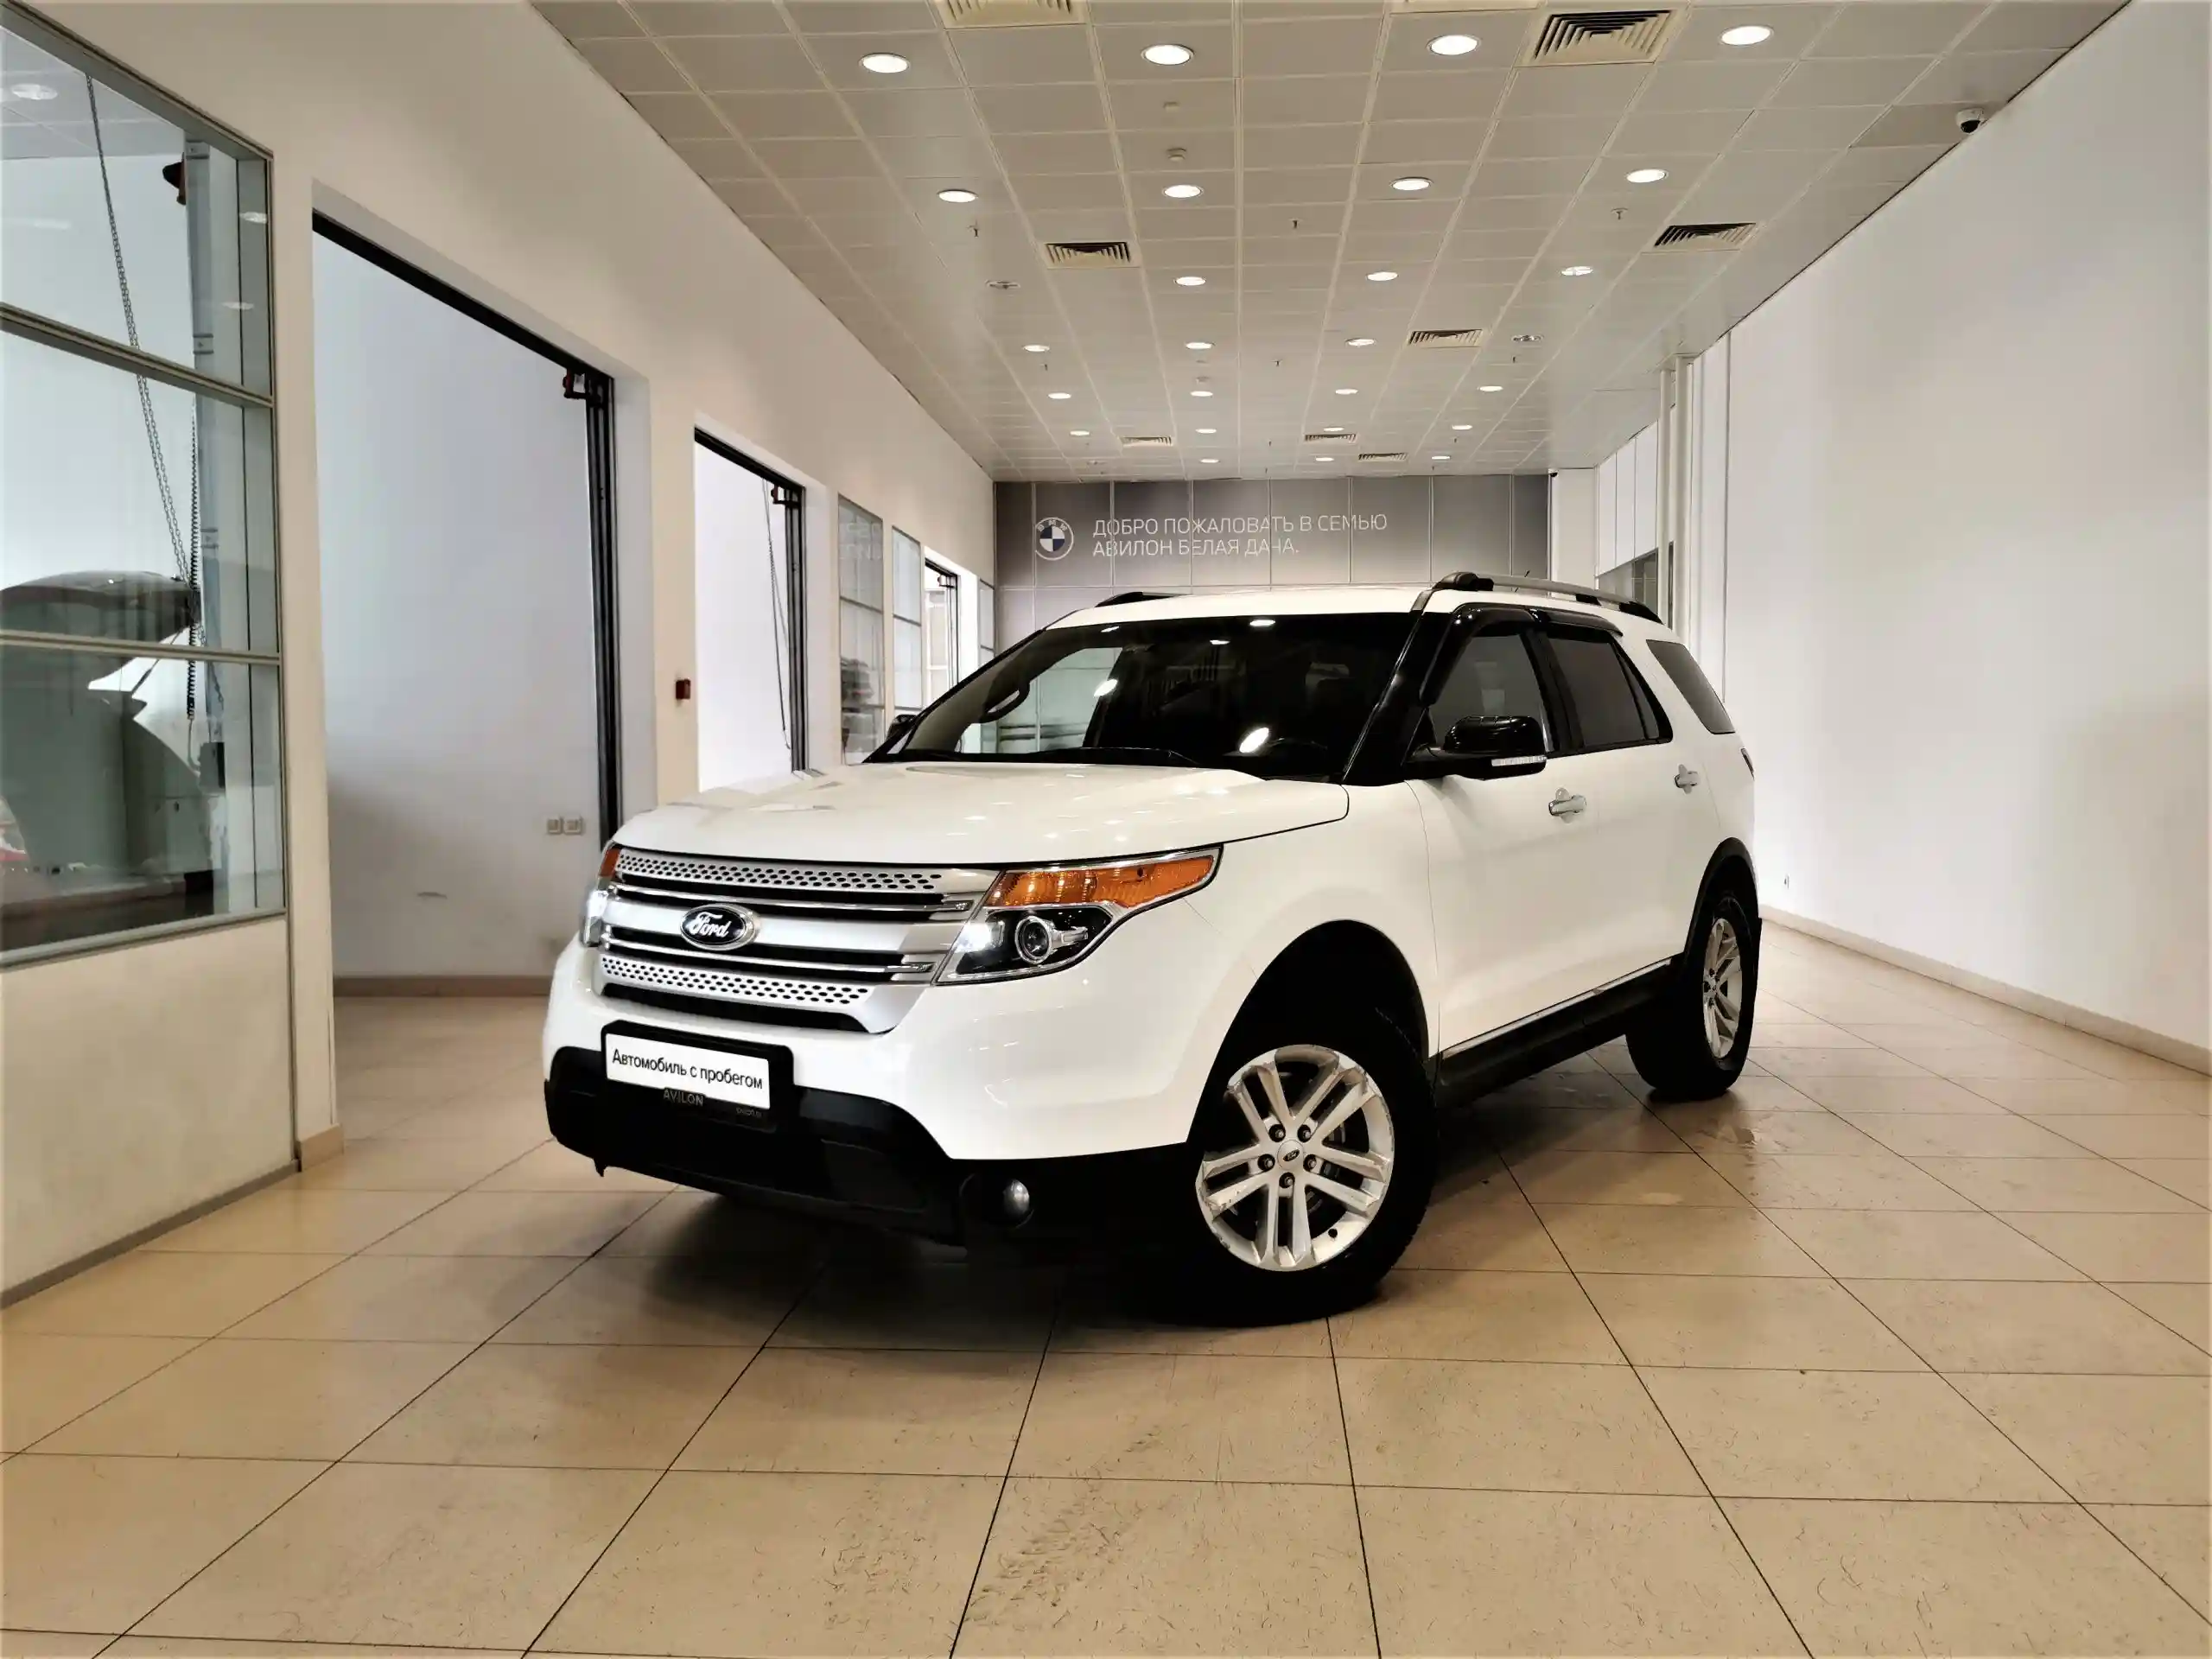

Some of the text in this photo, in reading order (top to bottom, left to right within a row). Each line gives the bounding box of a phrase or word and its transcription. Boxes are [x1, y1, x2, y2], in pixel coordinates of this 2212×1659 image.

[1092, 513, 1388, 538] ДОБРО ПОЖАЛОВАТЬ В СЕМЬЮ
[1092, 538, 1173, 557] АВИЛОН
[1179, 538, 1239, 556] БЕЛАЯ
[685, 912, 732, 938] Ford
[613, 1048, 763, 1090] Автомобиль с пробегом
[663, 1088, 704, 1107] AVILON
